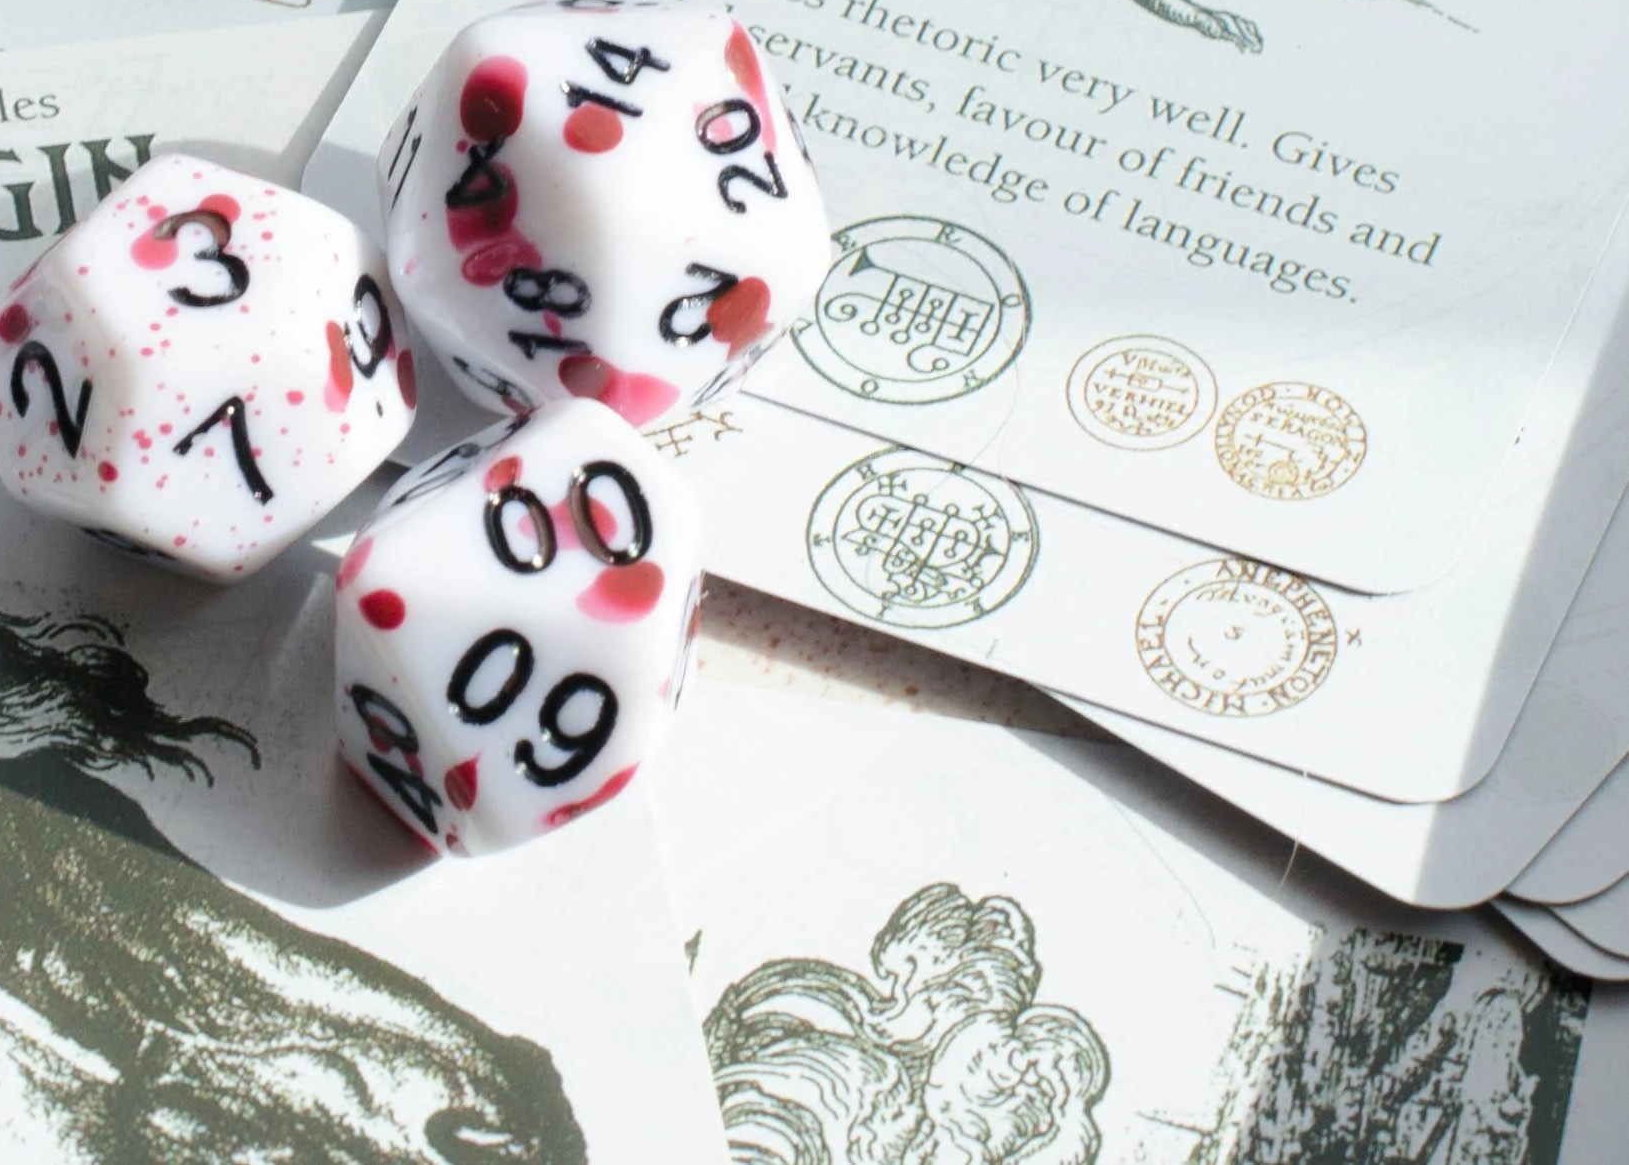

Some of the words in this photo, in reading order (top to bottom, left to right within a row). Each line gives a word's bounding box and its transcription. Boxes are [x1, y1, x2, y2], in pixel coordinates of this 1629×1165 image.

[558, 37, 671, 118] 14
[1037, 58, 1136, 115] very
[1149, 95, 1250, 149] well.
[1271, 130, 1400, 194] Gives
[694, 98, 789, 214] 20
[748, 23, 937, 114] servants,
[954, 84, 1108, 159] favour
[1118, 145, 1176, 180] of
[1174, 155, 1339, 235] friends
[1348, 222, 1442, 267] and
[802, 93, 1050, 205] knowledge
[1063, 188, 1121, 223] of
[1121, 198, 1358, 305] languages.
[153, 208, 250, 307] 3
[503, 267, 593, 361] 18
[658, 262, 741, 348] 2
[483, 460, 654, 575] 00
